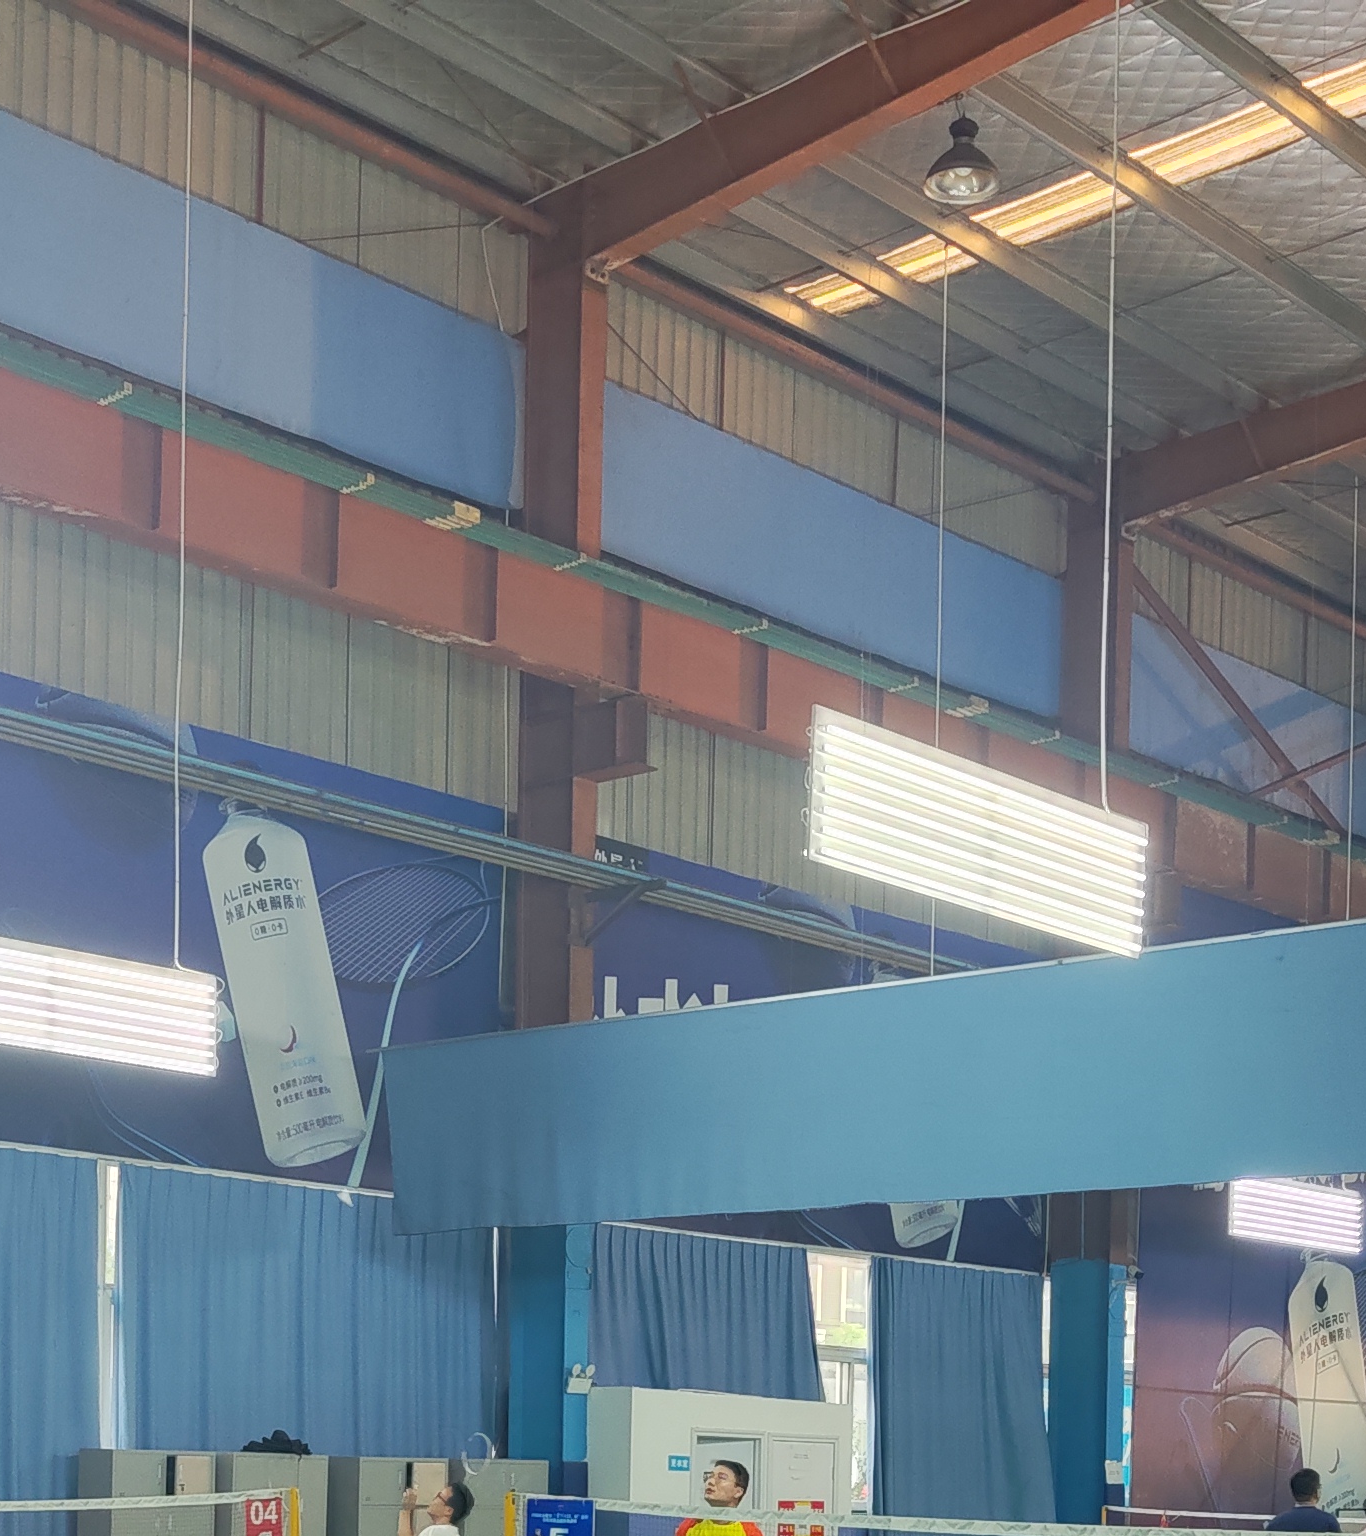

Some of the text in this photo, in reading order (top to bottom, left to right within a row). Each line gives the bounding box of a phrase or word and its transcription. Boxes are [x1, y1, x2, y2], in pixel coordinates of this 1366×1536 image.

[223, 878, 300, 906] ALIENERGY
[225, 894, 306, 925] 外星人电解质水
[1299, 1312, 1350, 1347] ALIENERGY
[250, 1500, 279, 1525] 04
